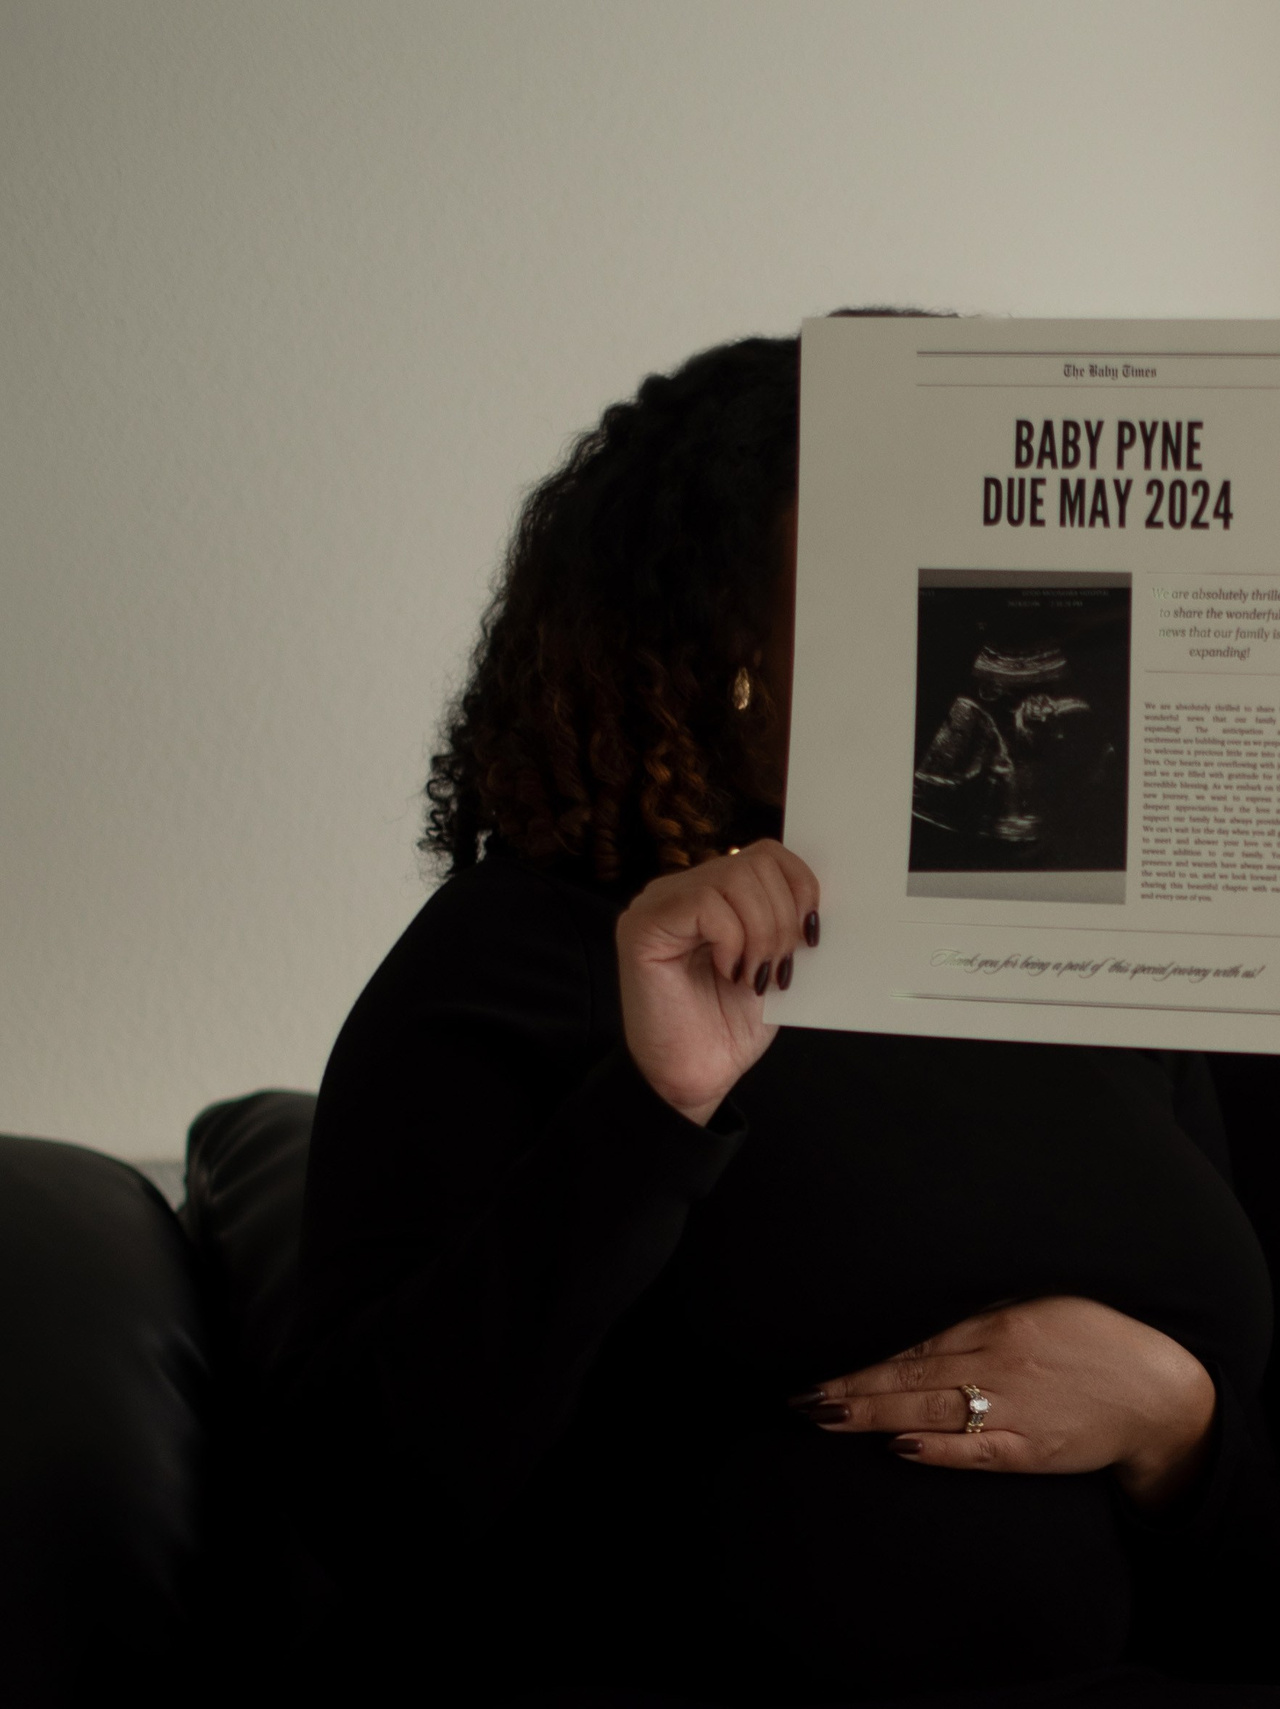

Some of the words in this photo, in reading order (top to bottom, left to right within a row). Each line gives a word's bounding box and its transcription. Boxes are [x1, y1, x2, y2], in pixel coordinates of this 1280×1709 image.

[1062, 362, 1086, 379] The
[1087, 362, 1119, 380] Baby
[1120, 362, 1157, 378] Times
[1014, 419, 1104, 469] BABY
[1115, 420, 1203, 471] PYNE
[982, 476, 1046, 527] DUE
[1058, 477, 1133, 528] MAY
[1144, 478, 1233, 529] 2024
[1171, 591, 1189, 600] are
[1191, 587, 1249, 604] absolutely
[1159, 607, 1171, 618] to
[1172, 605, 1204, 619] share
[1204, 605, 1224, 619] the
[1158, 626, 1187, 638] news
[1187, 624, 1212, 638] that
[1212, 628, 1234, 639] our
[1233, 625, 1271, 642] family
